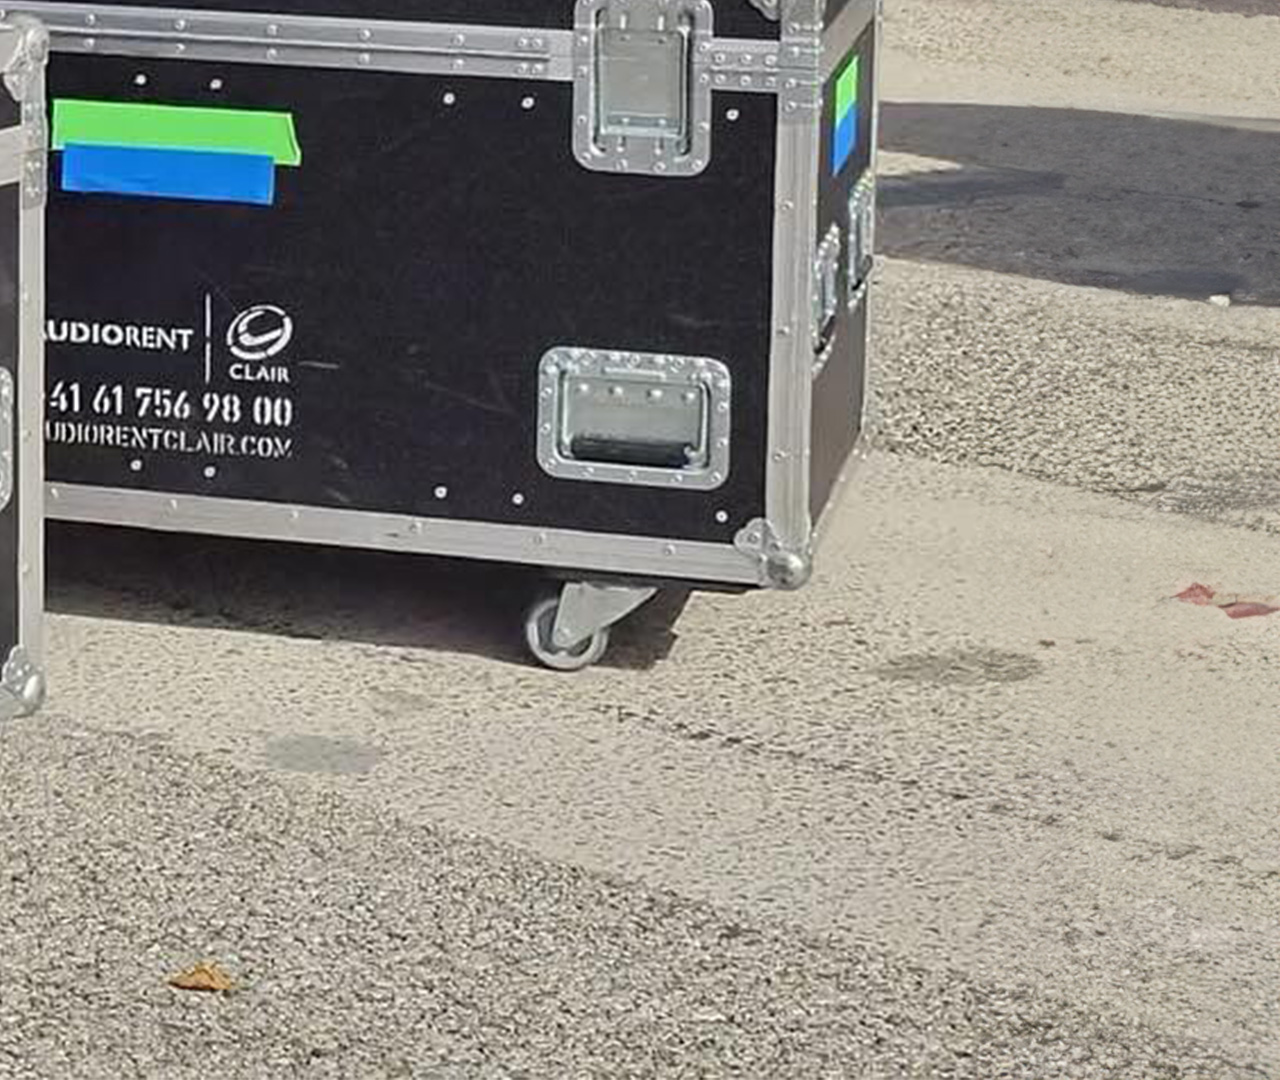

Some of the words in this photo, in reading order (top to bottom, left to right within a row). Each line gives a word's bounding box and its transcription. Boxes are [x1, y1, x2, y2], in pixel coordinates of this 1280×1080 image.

[42, 319, 194, 351] UDIORENT
[229, 363, 291, 383] CLAIR
[48, 381, 80, 413] 41
[93, 384, 124, 416] 61
[135, 387, 191, 420] 756
[203, 392, 242, 423] 98
[252, 396, 293, 427] 00
[45, 421, 292, 458] UDIORENTCLAIR.COM
